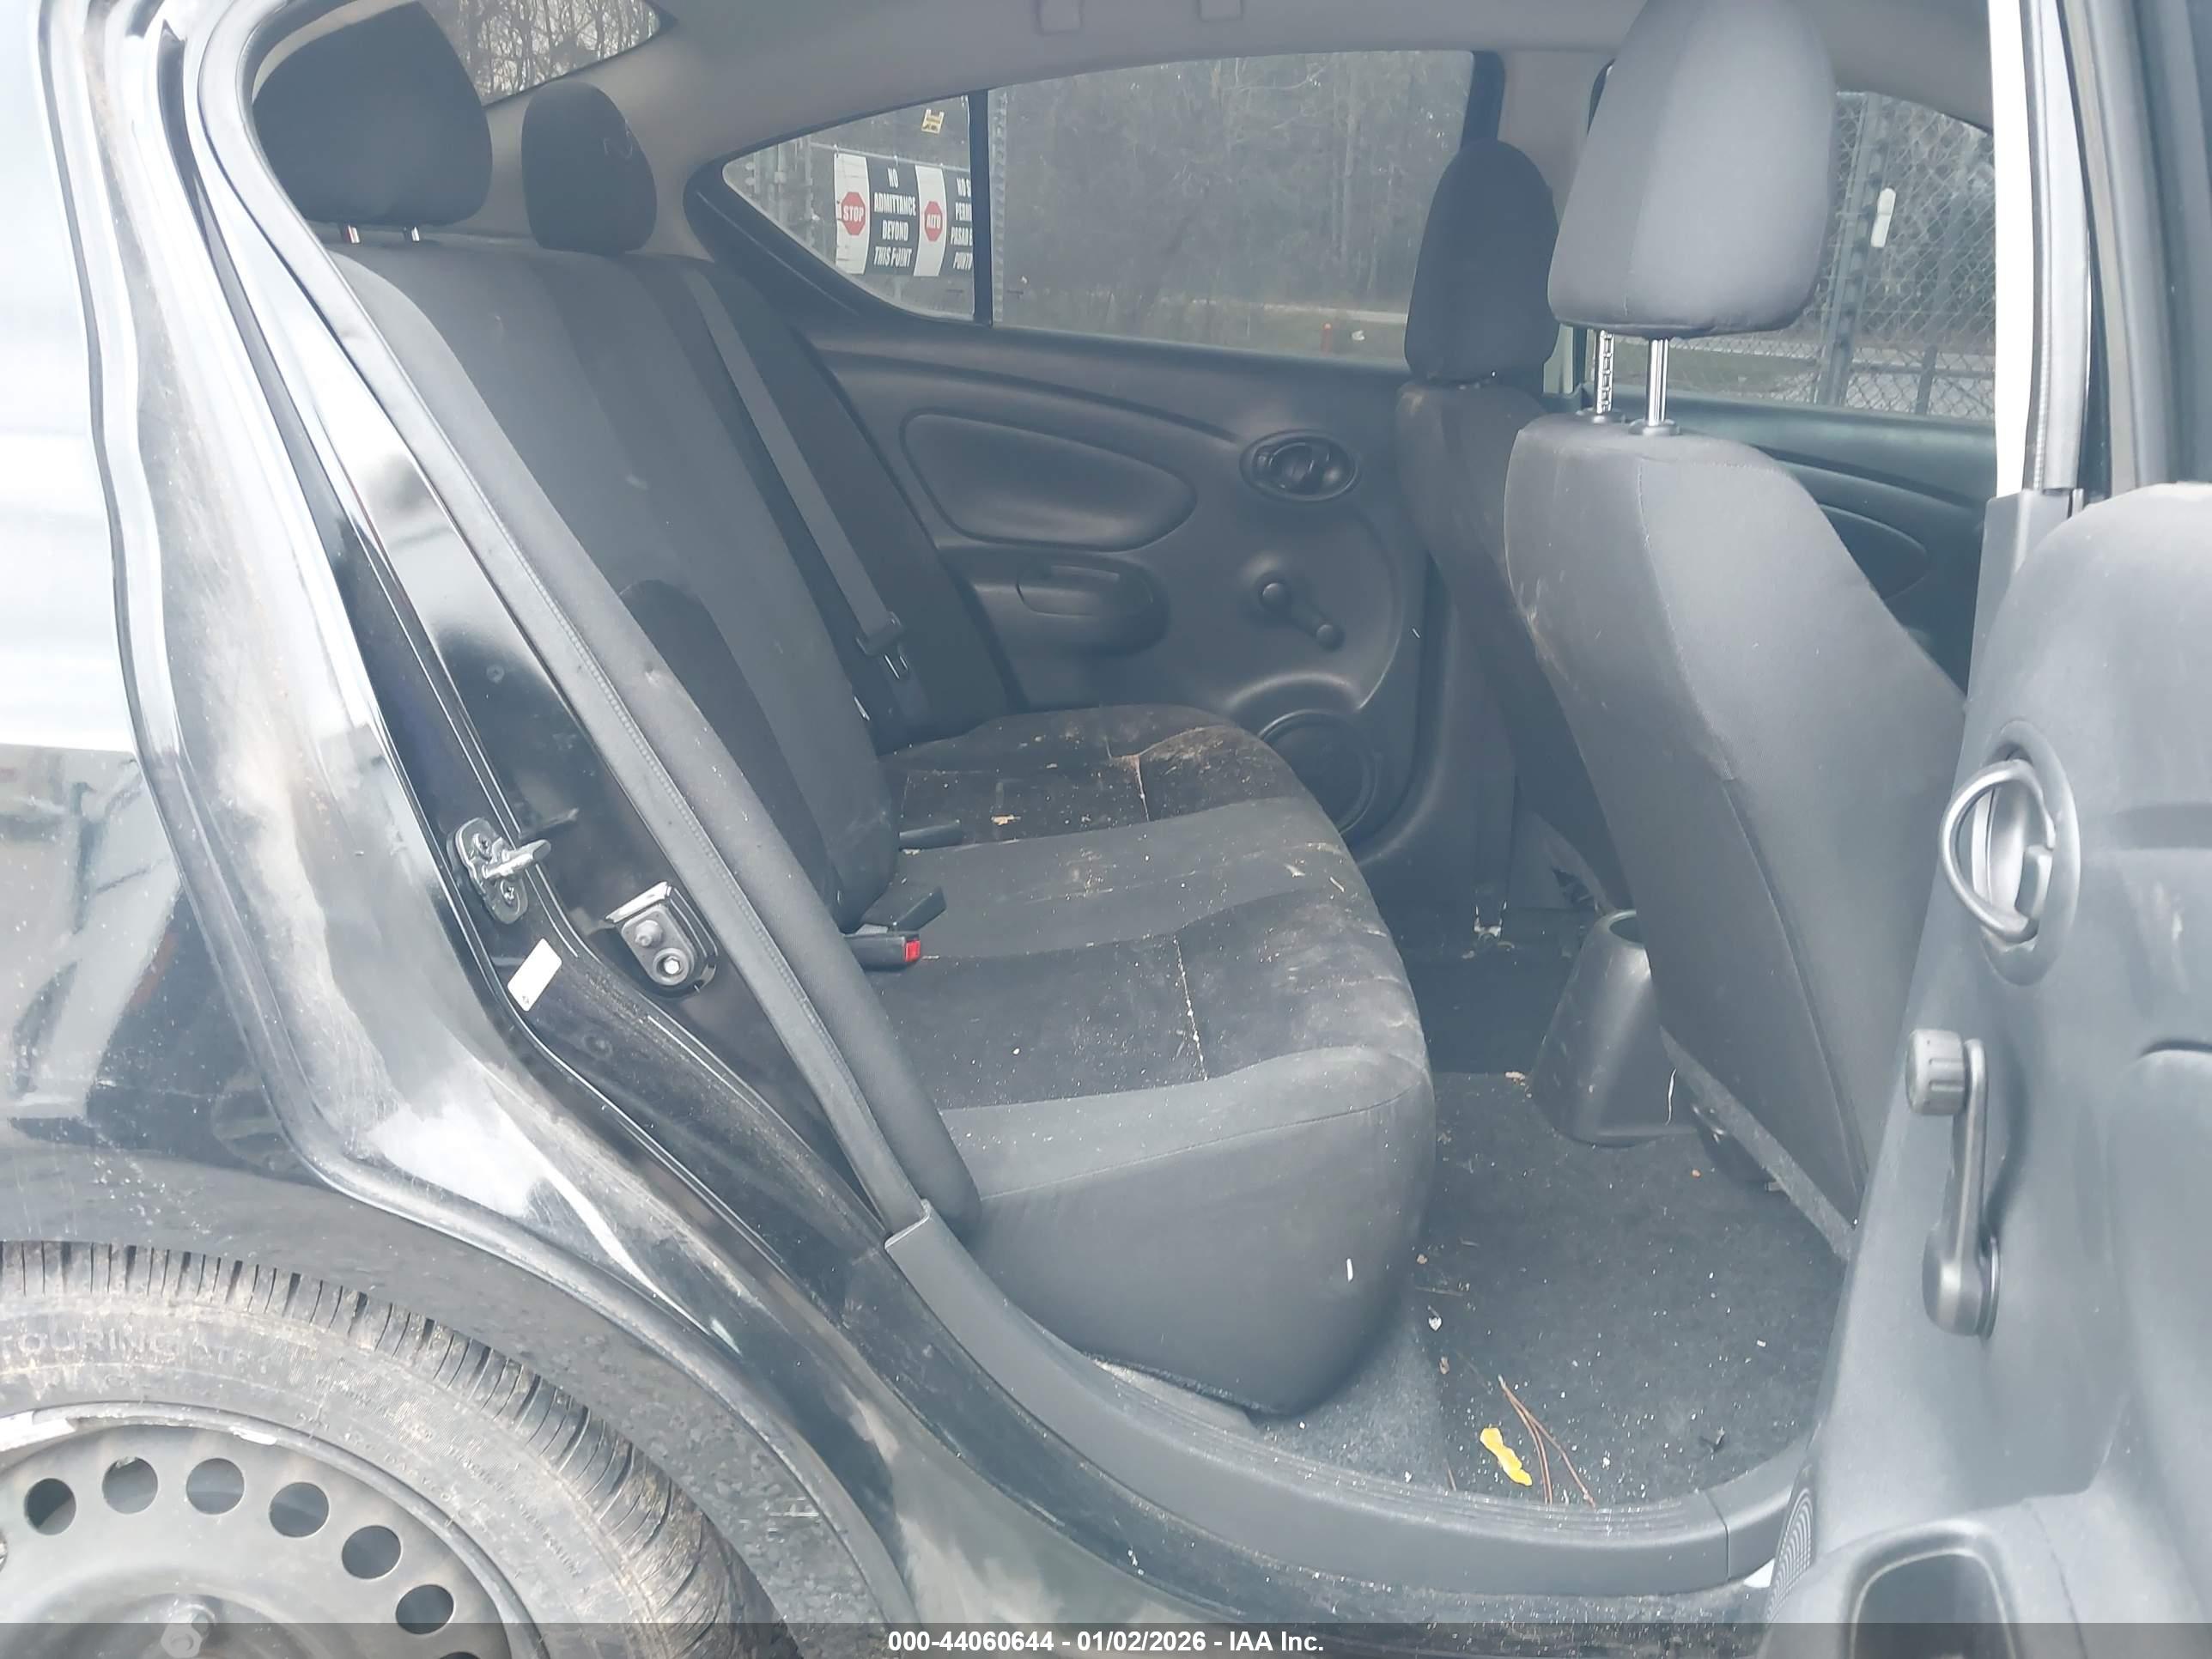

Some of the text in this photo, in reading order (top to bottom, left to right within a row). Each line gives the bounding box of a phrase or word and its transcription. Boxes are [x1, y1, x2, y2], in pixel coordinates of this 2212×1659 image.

[888, 168, 898, 188] NO
[956, 178, 965, 197] NO
[843, 206, 864, 222] STOP
[874, 192, 916, 216] ADMITTANCE
[882, 220, 908, 241] BEYOND
[927, 215, 941, 228] ALTO
[874, 246, 912, 268] THIS POINT
